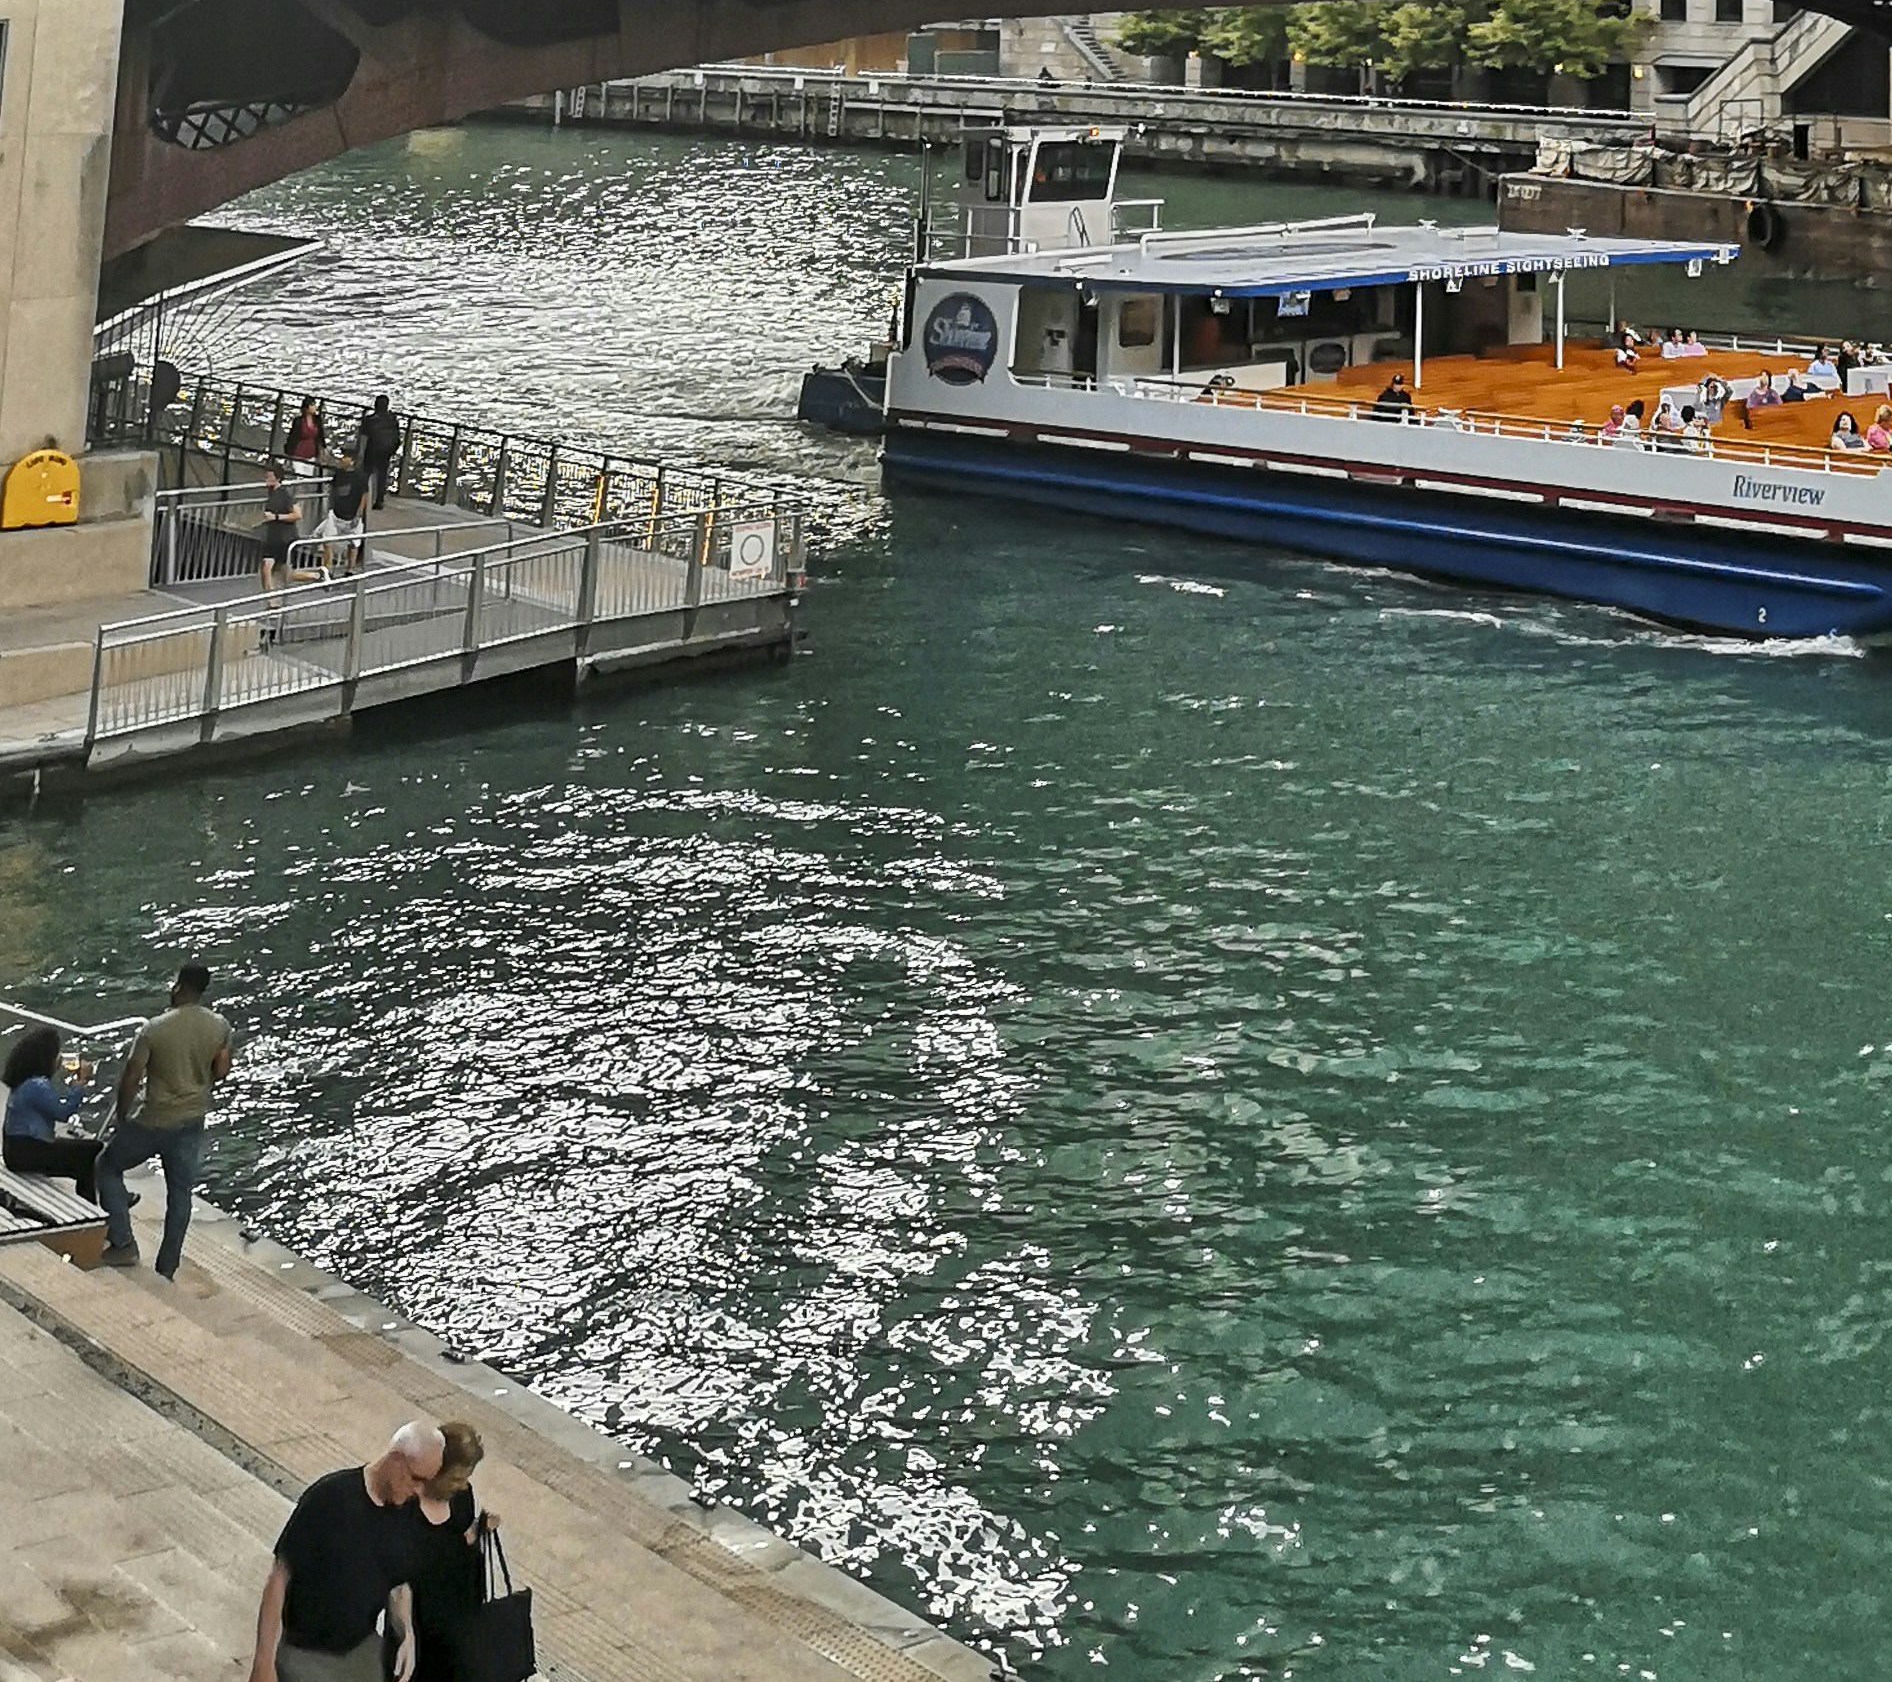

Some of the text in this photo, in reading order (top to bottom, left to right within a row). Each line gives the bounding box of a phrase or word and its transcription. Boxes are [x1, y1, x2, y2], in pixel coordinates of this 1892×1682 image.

[1406, 262, 1500, 283] SHORELINE
[1733, 474, 1826, 506] Riverview
[1758, 607, 1767, 624] 2
